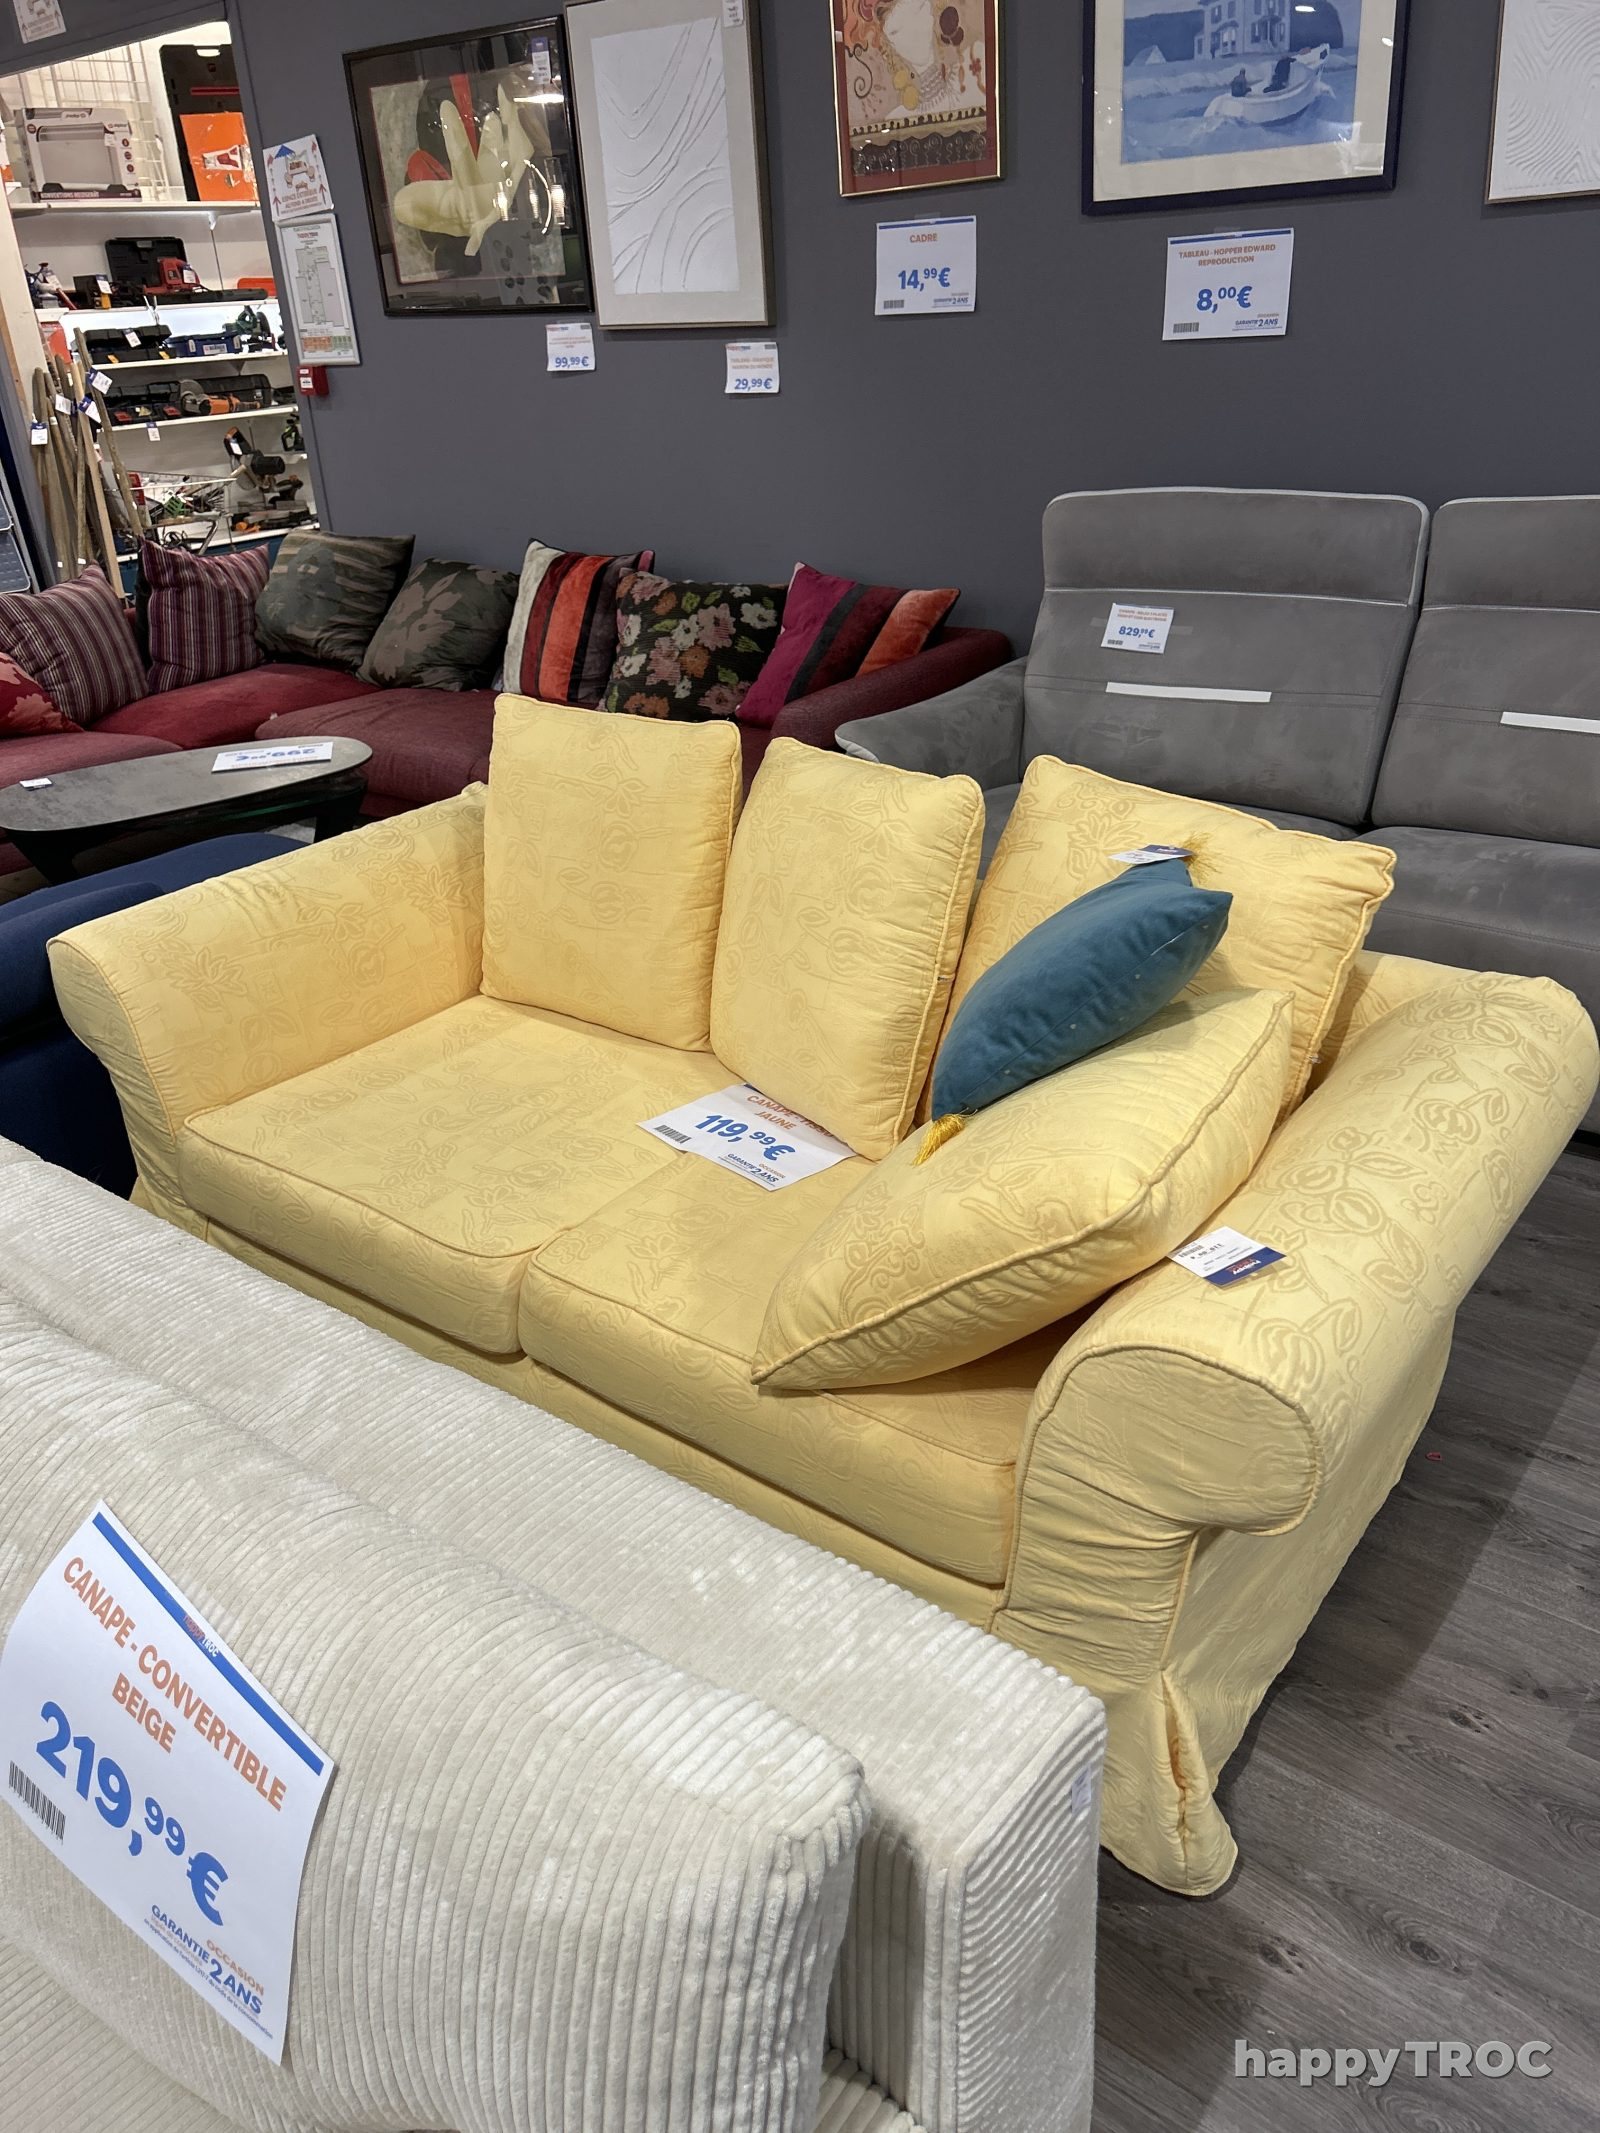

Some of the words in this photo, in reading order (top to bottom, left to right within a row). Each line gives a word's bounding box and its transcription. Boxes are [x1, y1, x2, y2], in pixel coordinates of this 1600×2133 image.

[909, 233, 938, 243] CADRE
[1179, 249, 1210, 259] TABLEAU
[1214, 245, 1243, 256] HOPPER
[1243, 243, 1276, 254] EDWARD
[1198, 255, 1255, 267] REPRODUCTION
[898, 267, 951, 292] 14,99€
[1196, 285, 1253, 313] 8,00€
[1258, 319, 1264, 327] 2
[1264, 318, 1279, 326] ANS
[555, 356, 589, 368] 99,99€
[734, 378, 773, 391] 29,99€
[747, 1095, 794, 1117] CANAPE
[754, 1111, 797, 1130] JAUNE
[695, 1114, 795, 1161] 119,99€
[727, 1153, 757, 1170] GARANTIE
[760, 1172, 779, 1182] ANS
[63, 1556, 136, 1648] CANAPE
[139, 1644, 287, 1812] CONVERTIBLE
[111, 1673, 177, 1754] BEIGE
[36, 1701, 229, 1926] 219,99€
[151, 1904, 210, 1963] GARANTIE
[209, 1958, 223, 1984] 2
[223, 1974, 263, 2014] ANS
[206, 1939, 264, 1996] OCCASION
